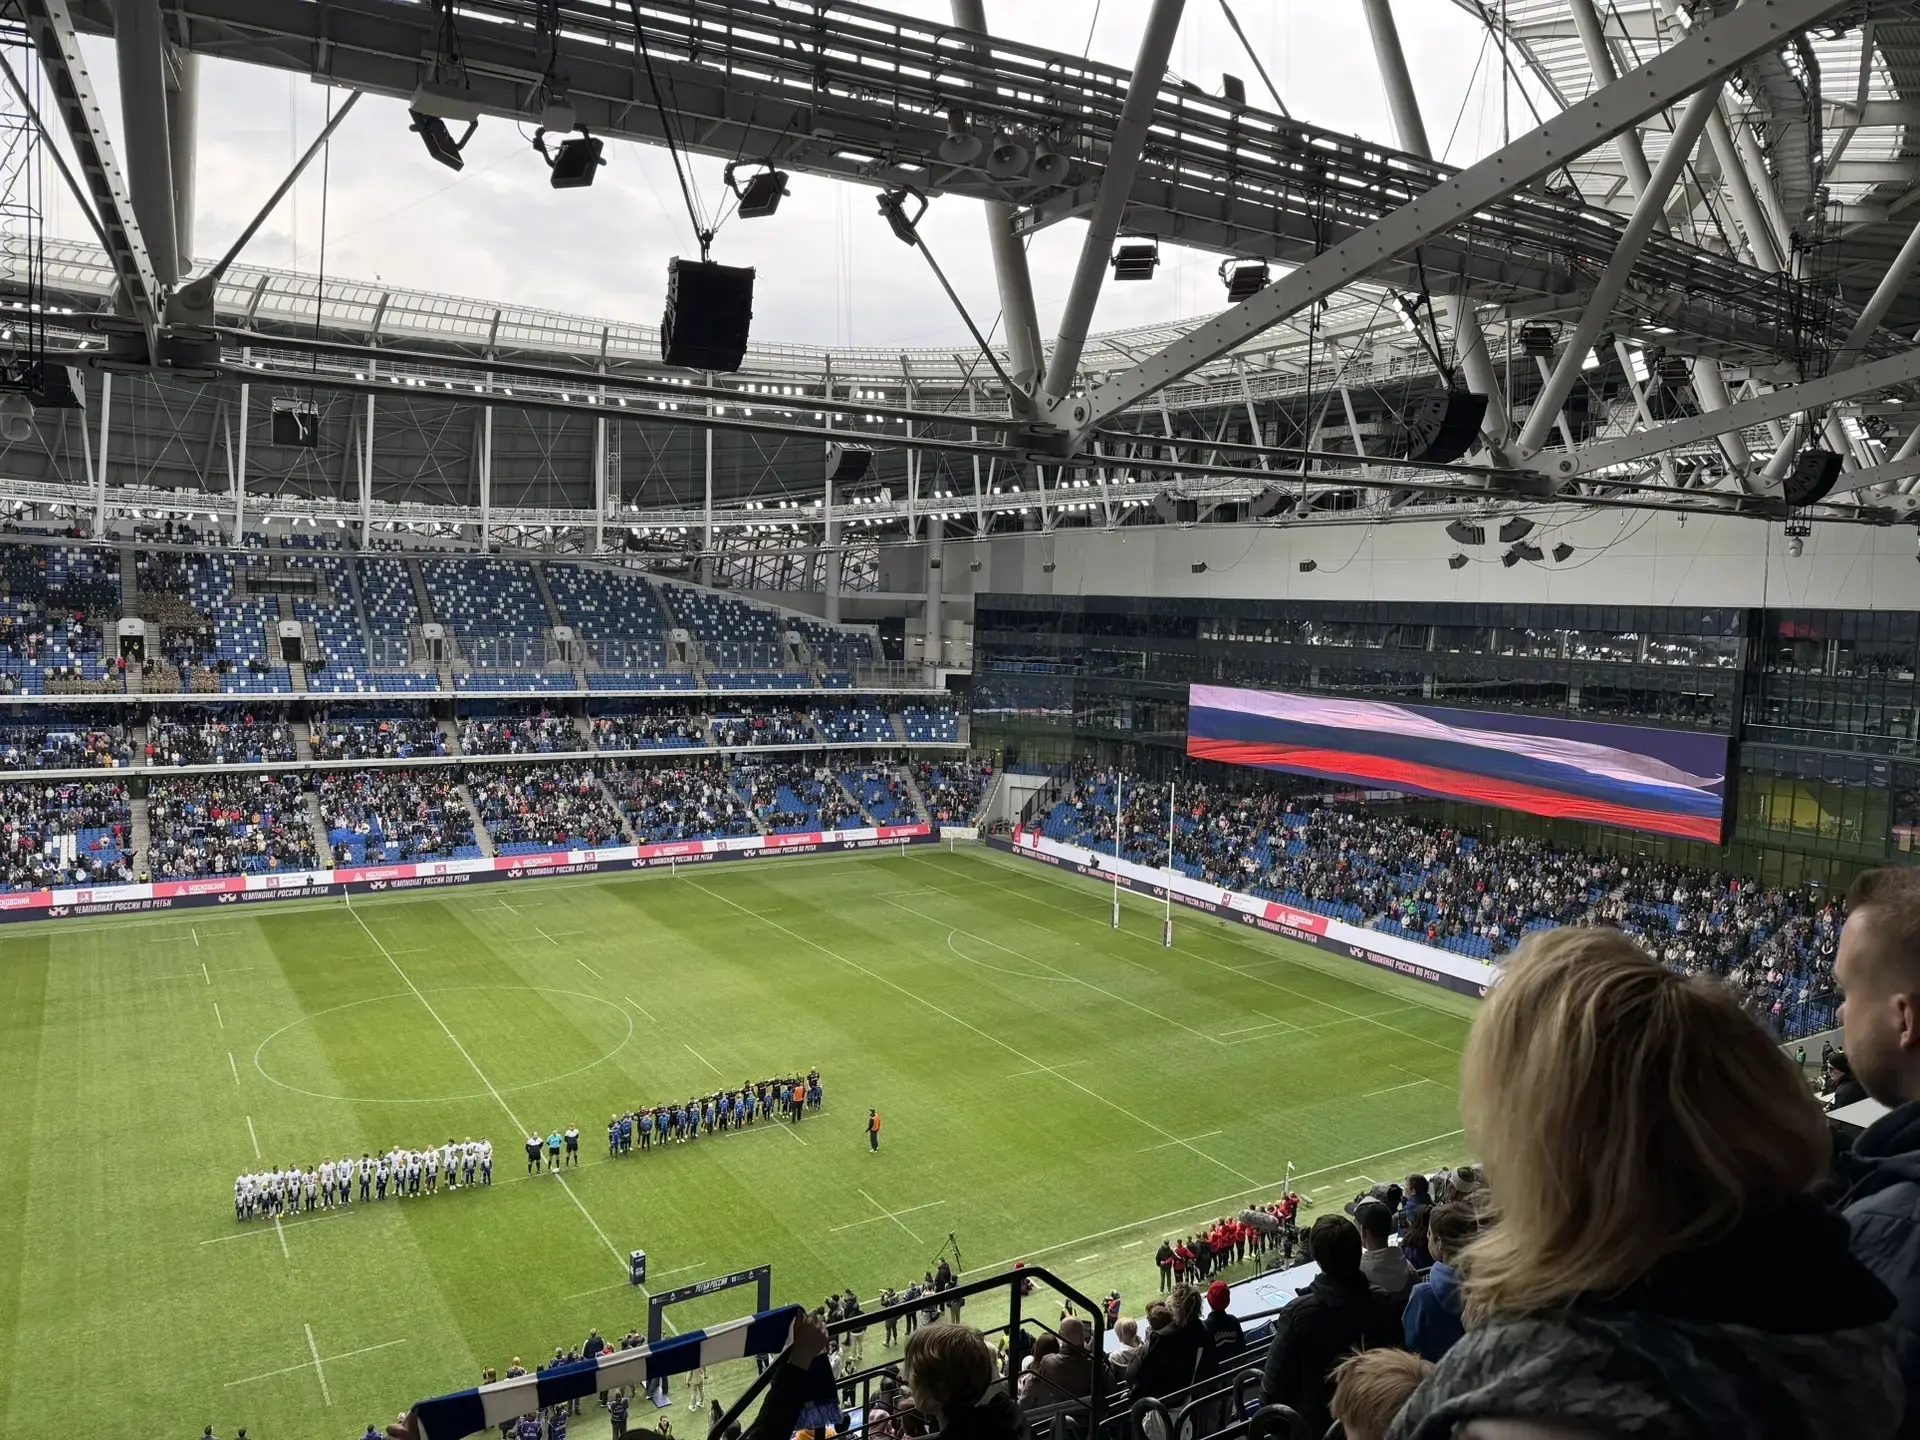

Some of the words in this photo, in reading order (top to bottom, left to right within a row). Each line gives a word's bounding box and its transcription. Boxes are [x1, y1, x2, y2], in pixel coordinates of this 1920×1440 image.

[556, 865, 575, 874] РОССИИ
[189, 882, 225, 892] МОСКОВСКИЙ
[390, 877, 422, 887] ЧЕМПИОНАТ
[423, 876, 444, 885] РОССИИ
[454, 874, 470, 882] РЕГБИ
[242, 891, 276, 901] ЧЕМПИОНАТ
[277, 889, 300, 897] РОССИИ
[312, 887, 328, 895] РЕГБИ
[74, 903, 113, 914] ЧЕМПИОНАТ
[114, 902, 141, 911] РОССИИ
[153, 899, 171, 908] РЕГБИ
[1280, 926, 1297, 936] РОССИИ
[1367, 952, 1395, 967] ЧЕМПИОНАТ
[1395, 961, 1415, 973] РОССИИ
[1424, 970, 1439, 981] РЕГБИ
[695, 1282, 710, 1293] РЕГБИ
[710, 1278, 728, 1288] РОССИИ
